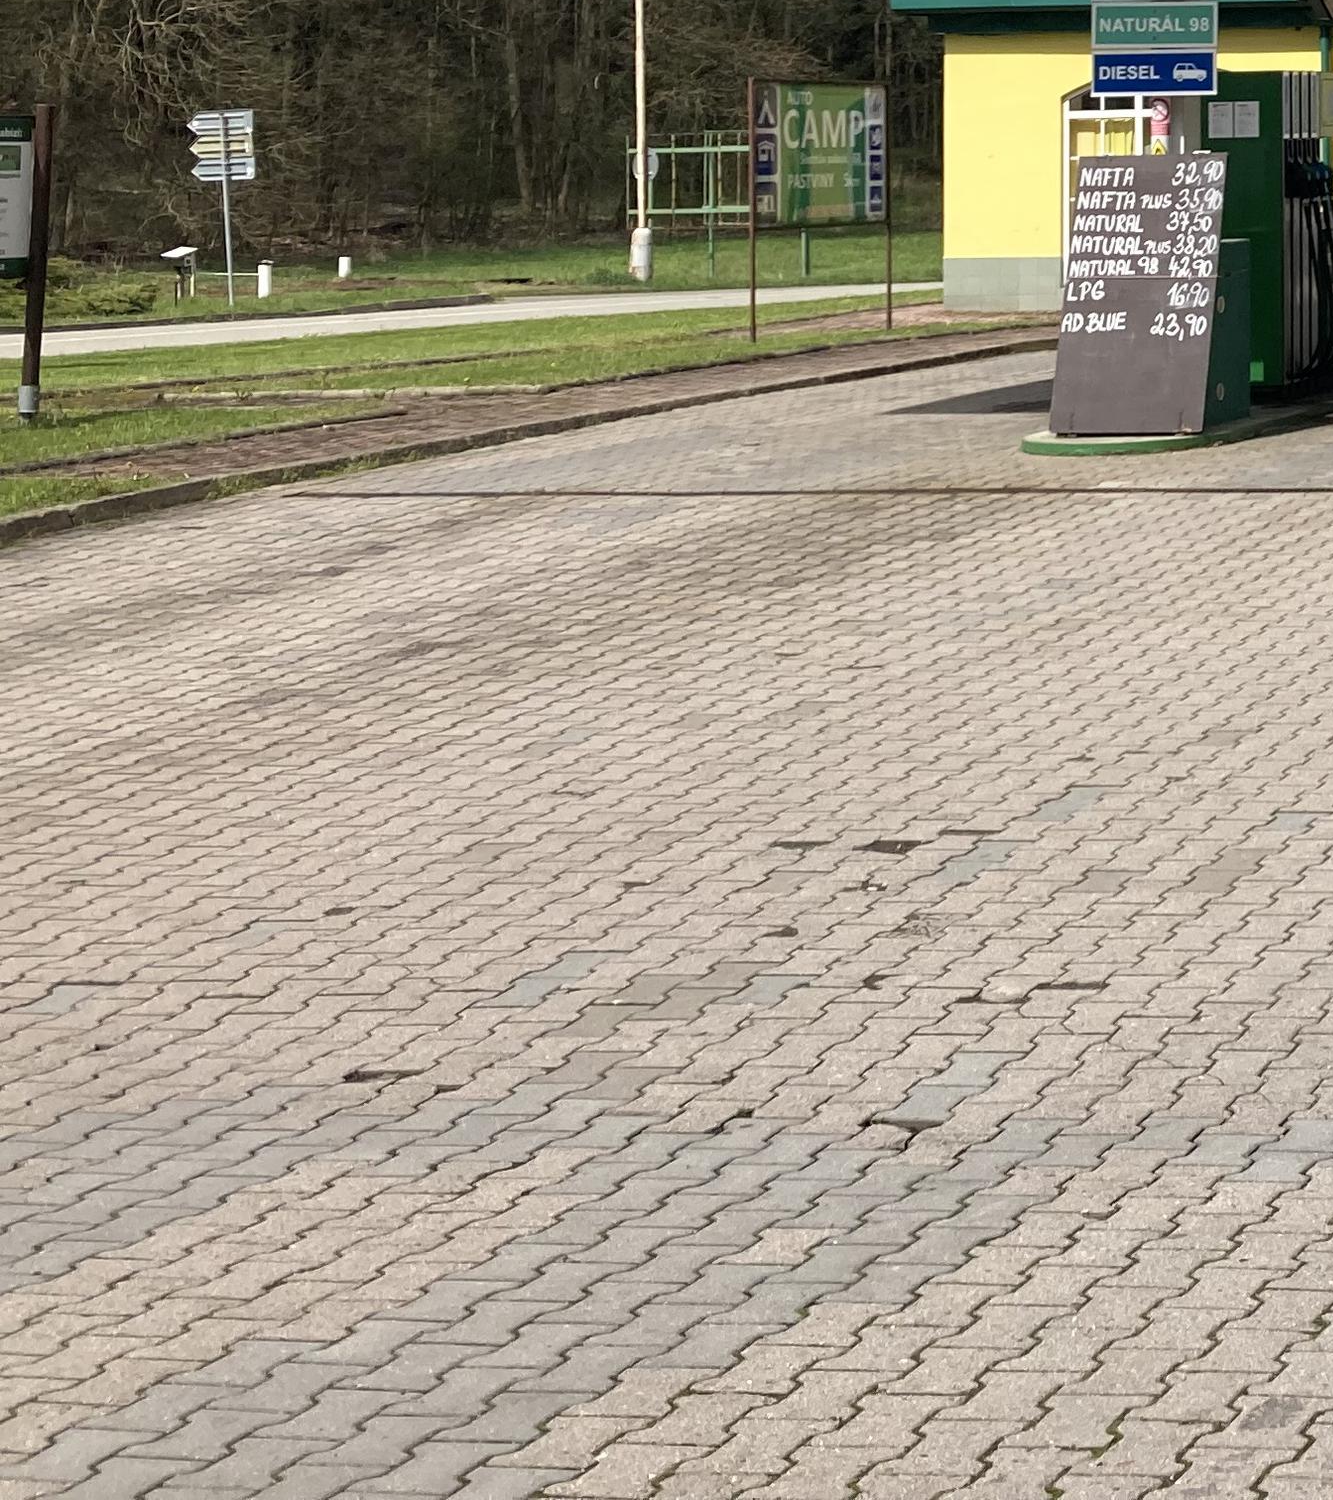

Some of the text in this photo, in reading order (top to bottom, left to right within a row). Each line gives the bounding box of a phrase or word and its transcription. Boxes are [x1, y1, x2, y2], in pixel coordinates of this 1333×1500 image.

[1099, 15, 1209, 32] NATURÁL 98
[1099, 65, 1160, 80] DIESEL
[787, 91, 814, 105] AUTO
[784, 109, 864, 148] CAMP
[1080, 160, 1224, 187] NAFTA 32,90
[1077, 188, 1224, 212] NAFTA PLUS 35,90
[1073, 211, 1212, 235] NATURAL 37,50
[1071, 234, 1218, 258] NATURAL PLUS 38,20
[1069, 256, 1213, 280] NATURAL 98 42,90
[1067, 280, 1210, 308] LPG 16,90
[1150, 312, 1208, 341] 23,90
